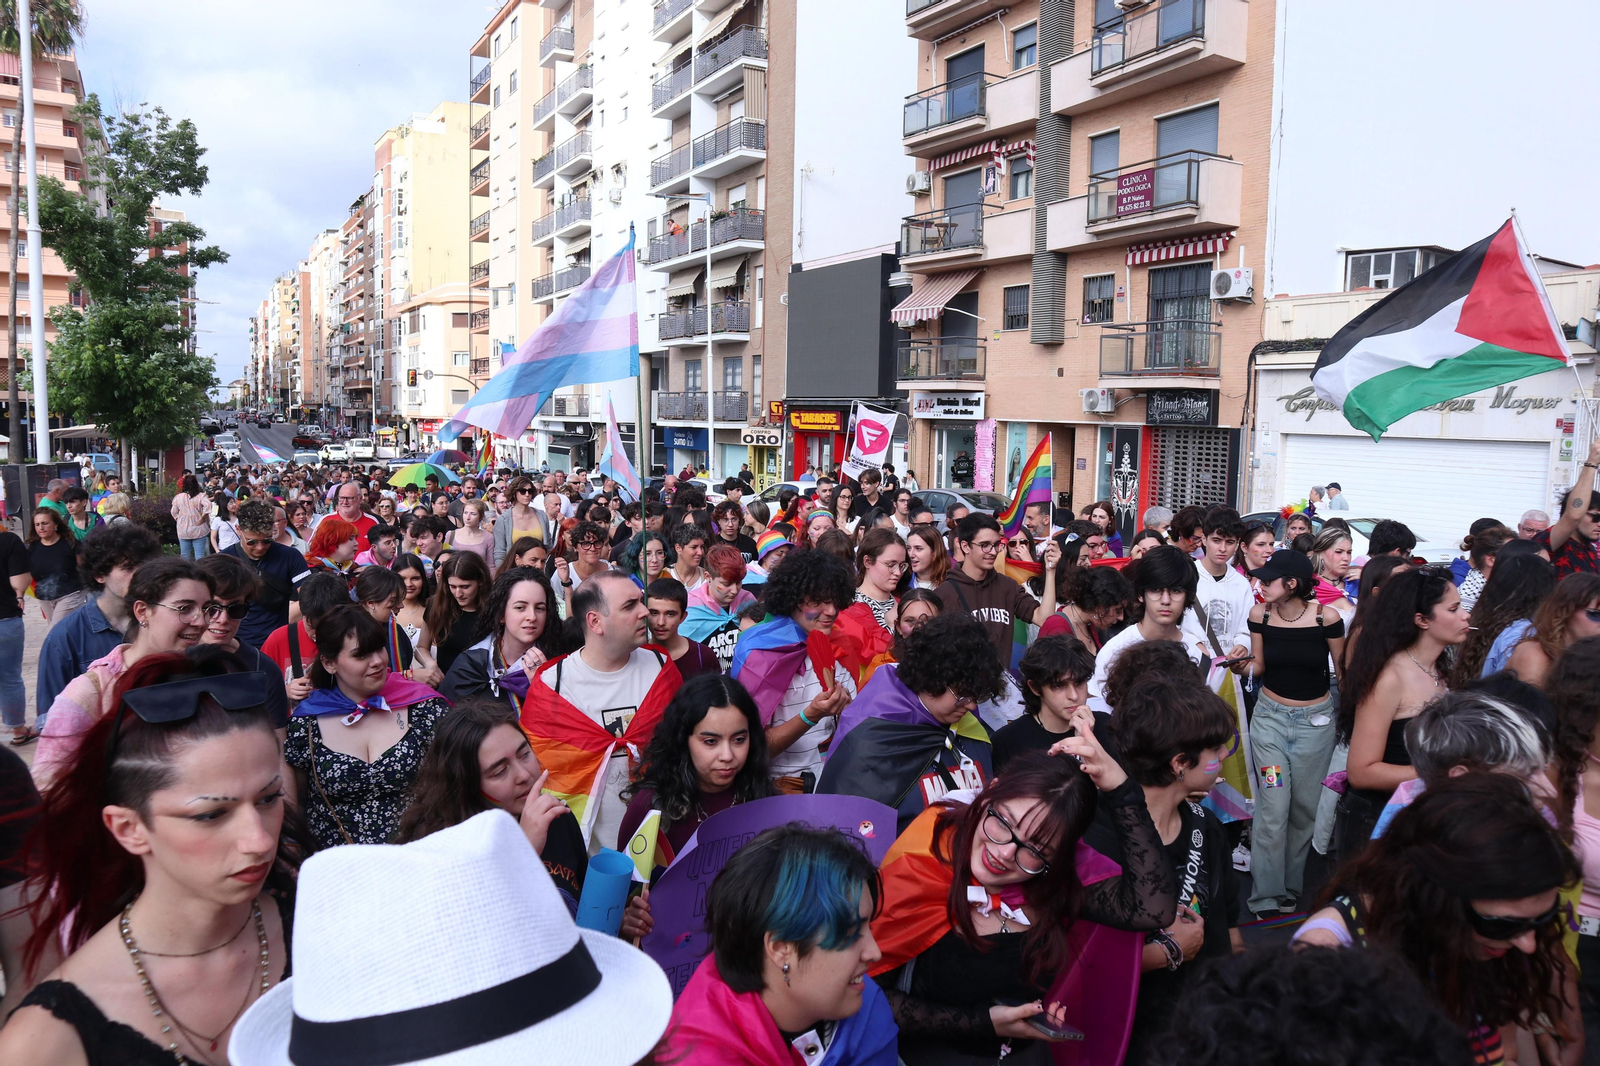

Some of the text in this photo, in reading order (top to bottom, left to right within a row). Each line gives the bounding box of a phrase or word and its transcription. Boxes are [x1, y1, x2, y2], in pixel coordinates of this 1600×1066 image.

[1122, 174, 1147, 187] CLÍNICA
[1489, 385, 1563, 415] Moguer
[800, 412, 837, 424] TABACOS
[742, 434, 779, 445] ORO
[980, 607, 1010, 625] VIBES
[1178, 848, 1202, 909] WOMA
